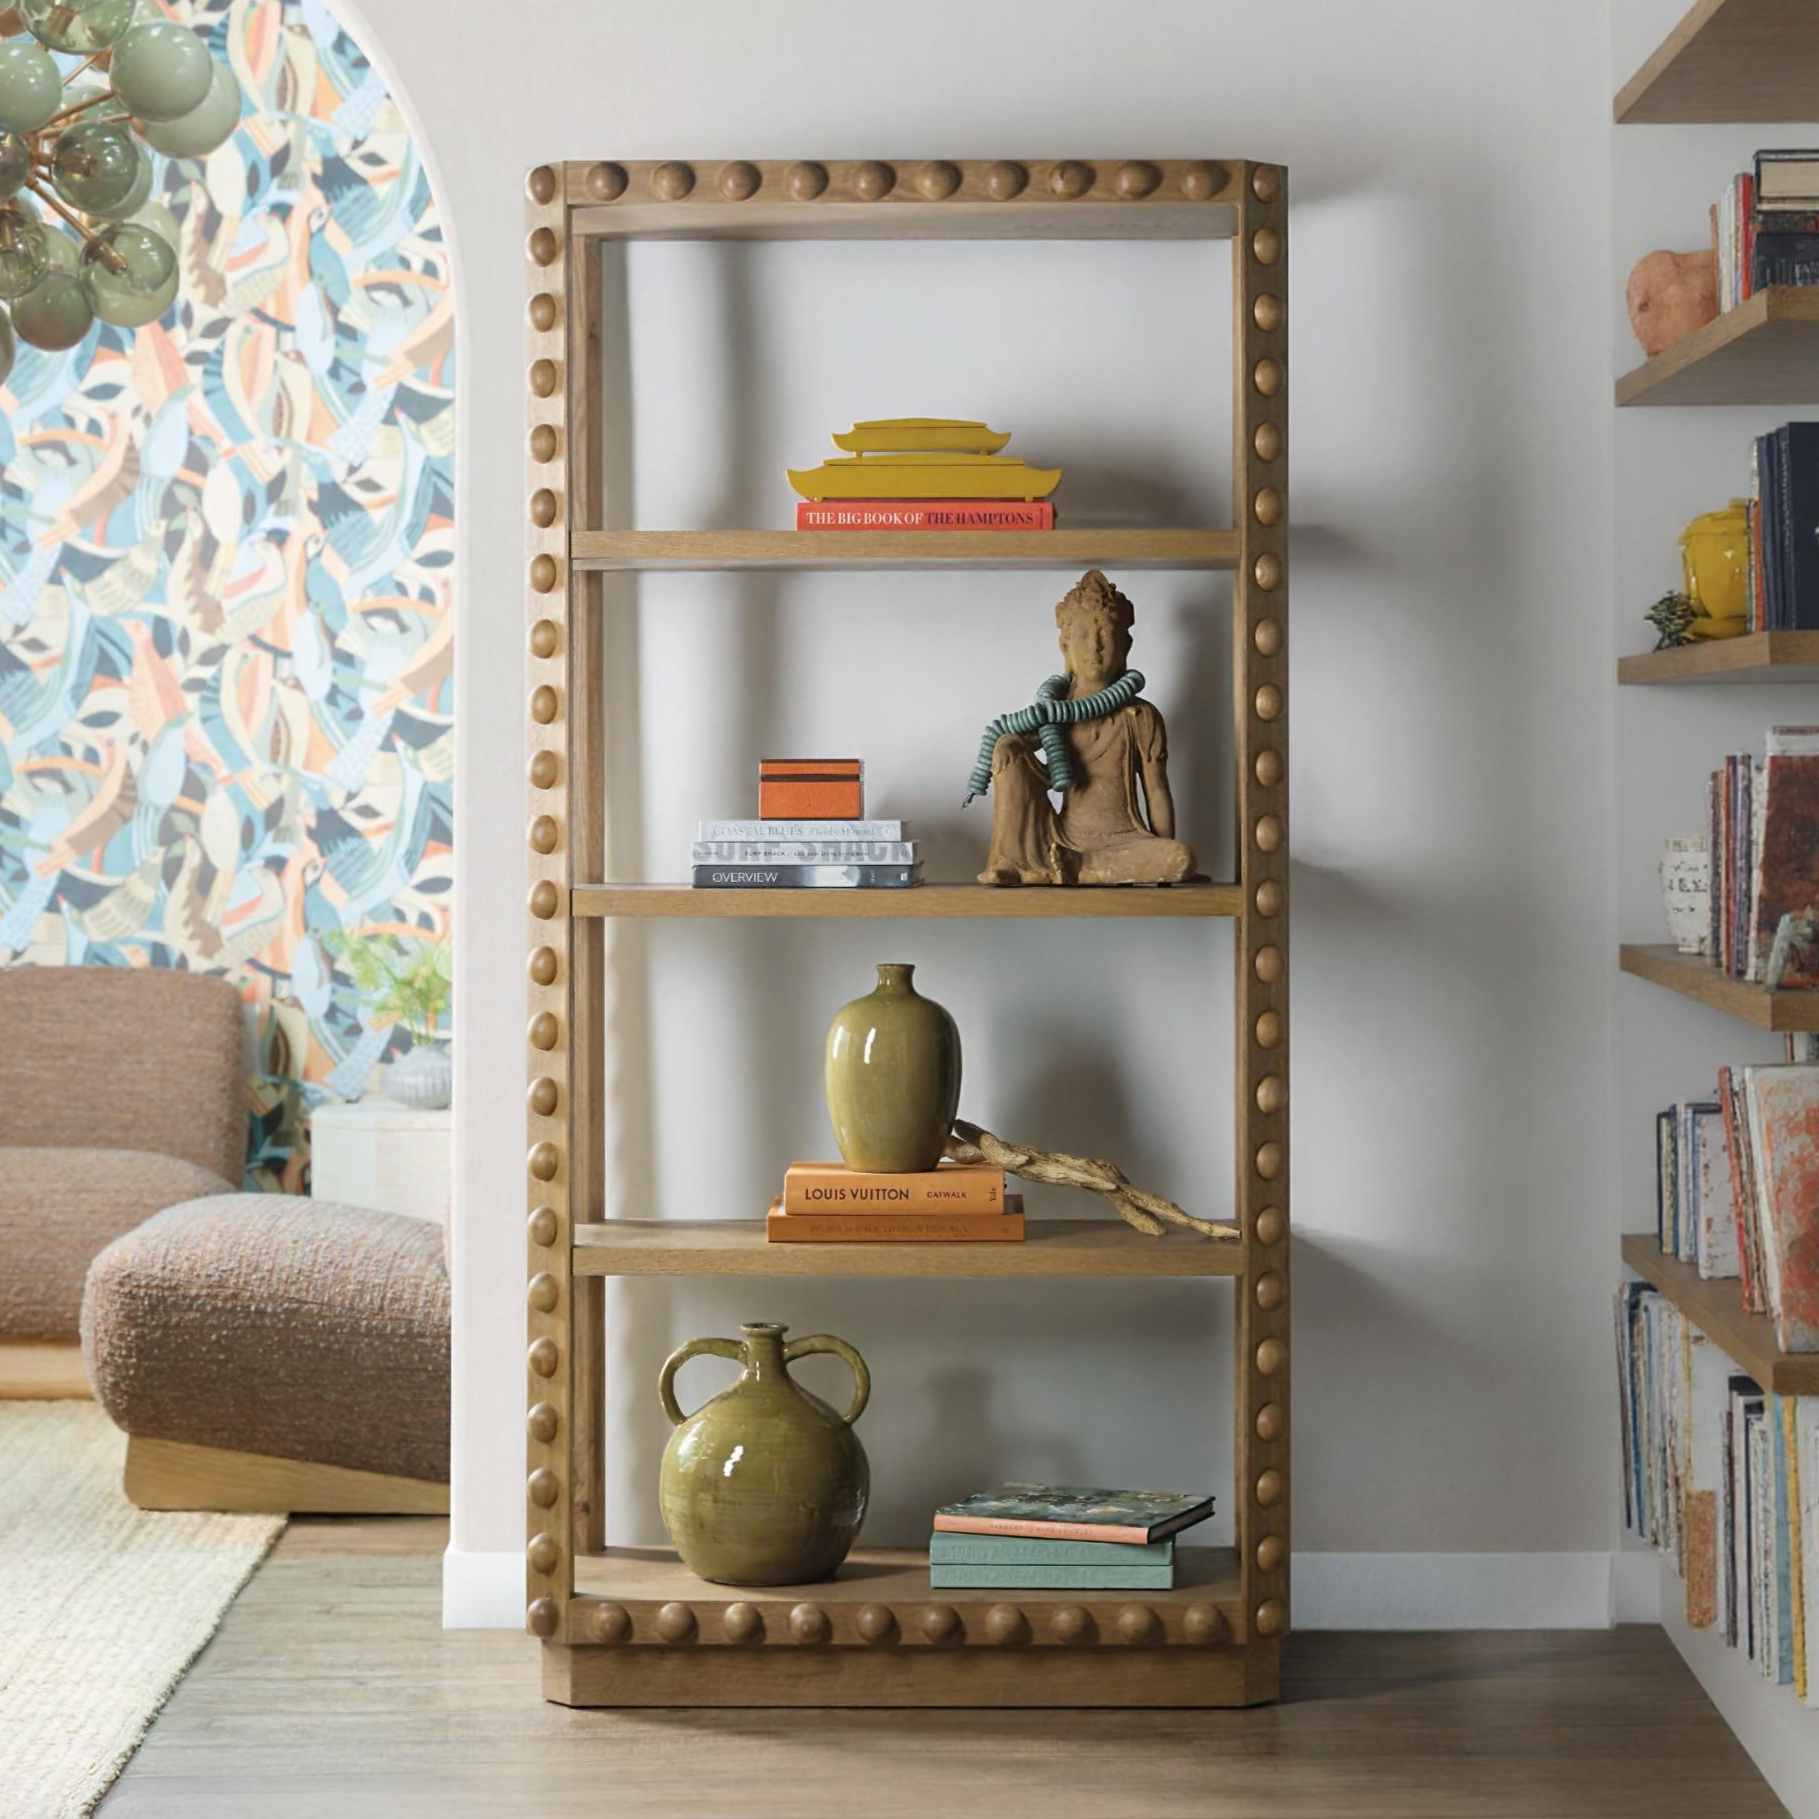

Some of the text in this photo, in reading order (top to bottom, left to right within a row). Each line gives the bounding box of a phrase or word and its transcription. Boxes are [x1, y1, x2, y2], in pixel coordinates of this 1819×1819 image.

[806, 512, 835, 525] THE
[837, 512, 861, 525] BIG
[863, 512, 902, 525] BOOK
[904, 512, 923, 525] OF
[925, 512, 954, 525] THE
[956, 512, 1034, 525] HAMPTONS
[712, 825, 764, 837] COASTAL
[712, 872, 778, 883] OVERVIEW
[805, 1188, 910, 1201] LOUIS VUITTON
[926, 1191, 967, 1199] CATWALK
